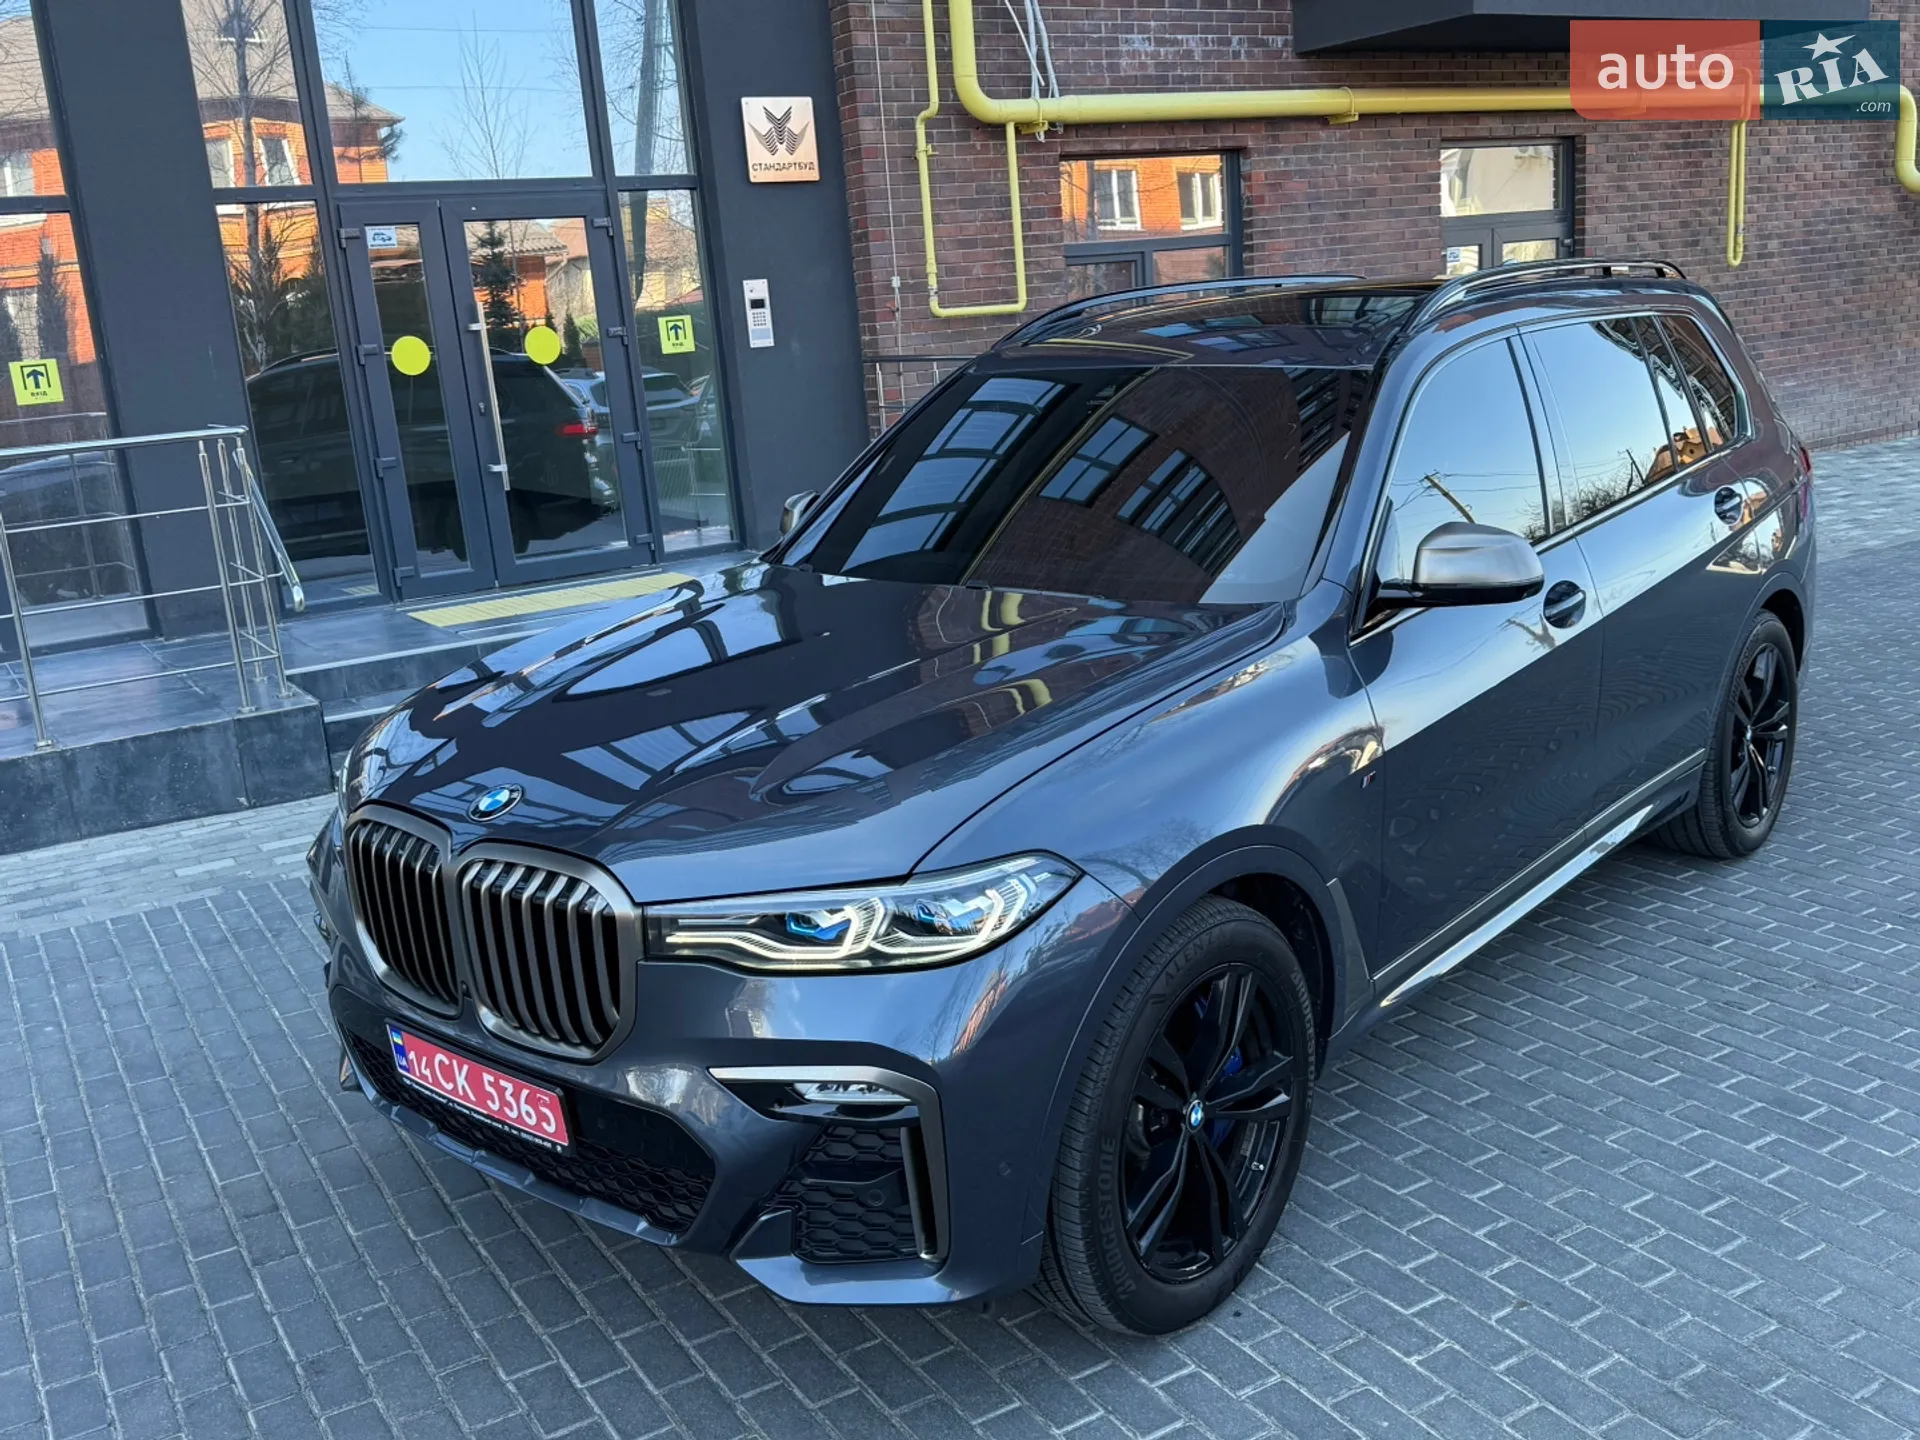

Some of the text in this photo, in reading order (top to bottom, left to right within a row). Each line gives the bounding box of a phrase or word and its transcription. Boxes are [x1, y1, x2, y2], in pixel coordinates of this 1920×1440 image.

[751, 161, 815, 172] СТАНДАРТБУД
[482, 1071, 557, 1134] 5365
[1098, 1136, 1138, 1301] BRIDGESTONE
